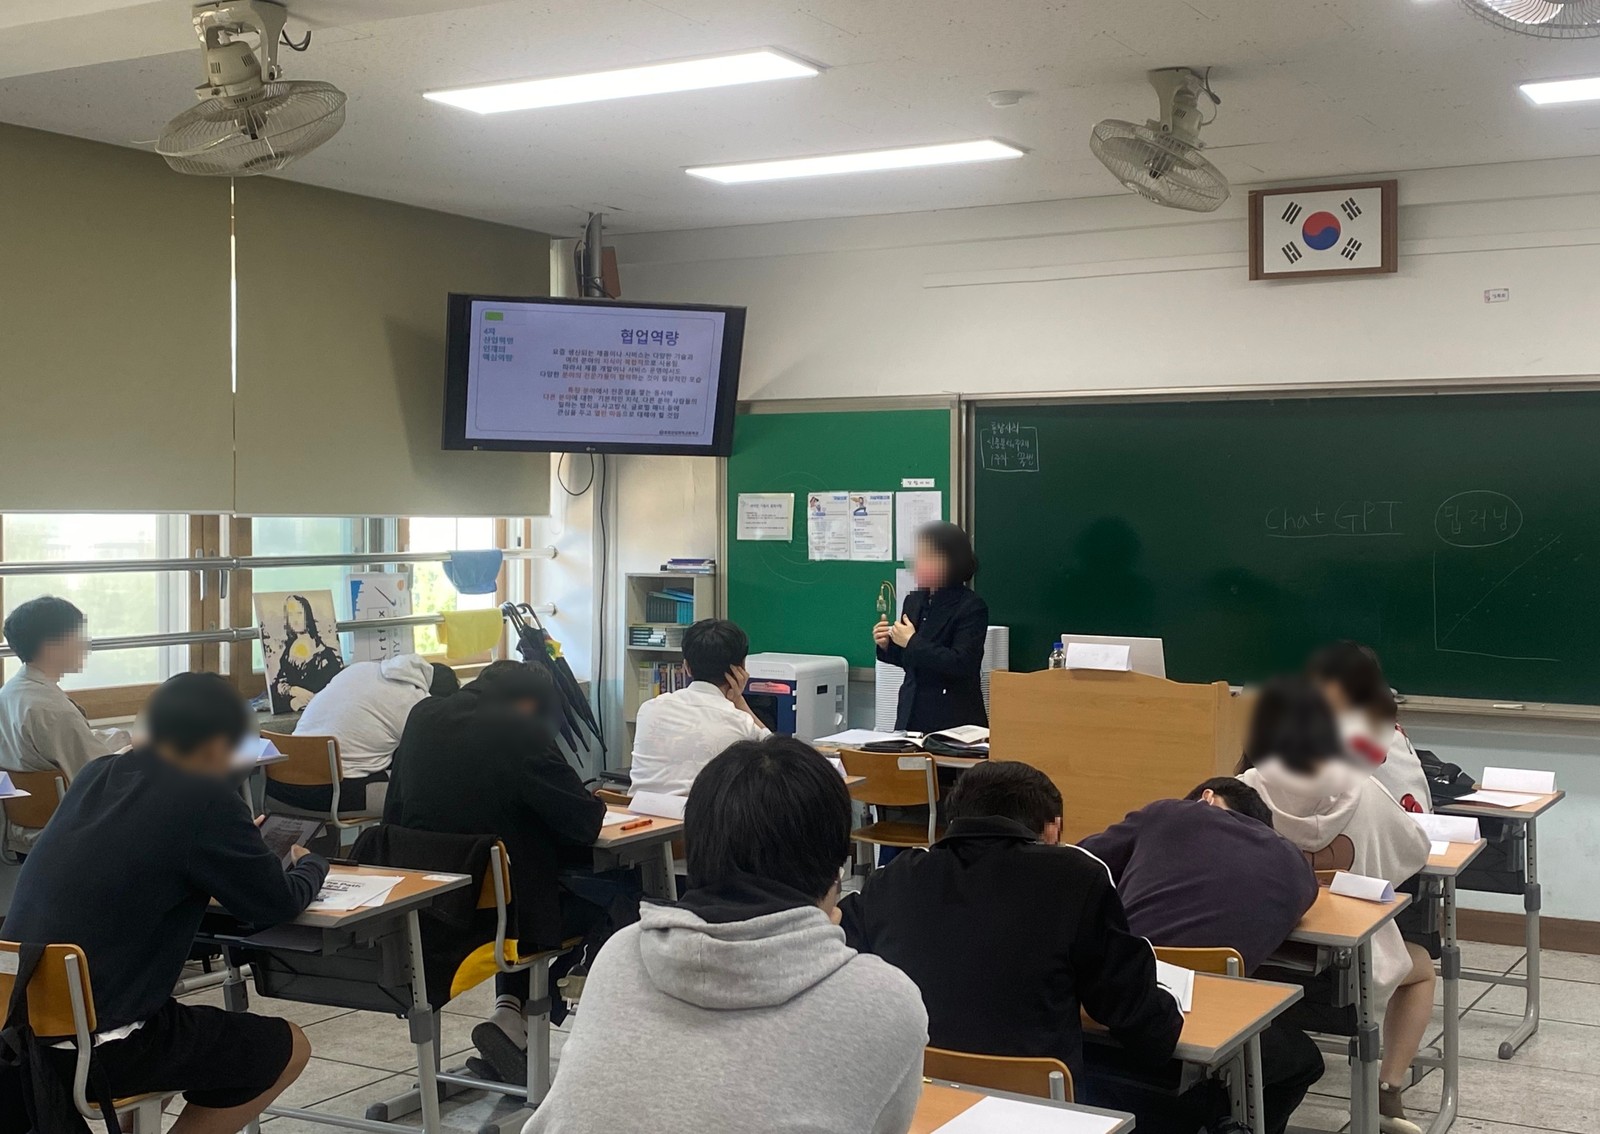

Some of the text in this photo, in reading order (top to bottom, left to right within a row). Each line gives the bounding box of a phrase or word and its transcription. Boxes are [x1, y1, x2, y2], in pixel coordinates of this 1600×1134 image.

[620, 327, 680, 346] 협업역량
[625, 351, 651, 359] 서비스는
[652, 352, 672, 360] 다양한
[539, 370, 560, 379] 다양한
[580, 394, 593, 402] 대한
